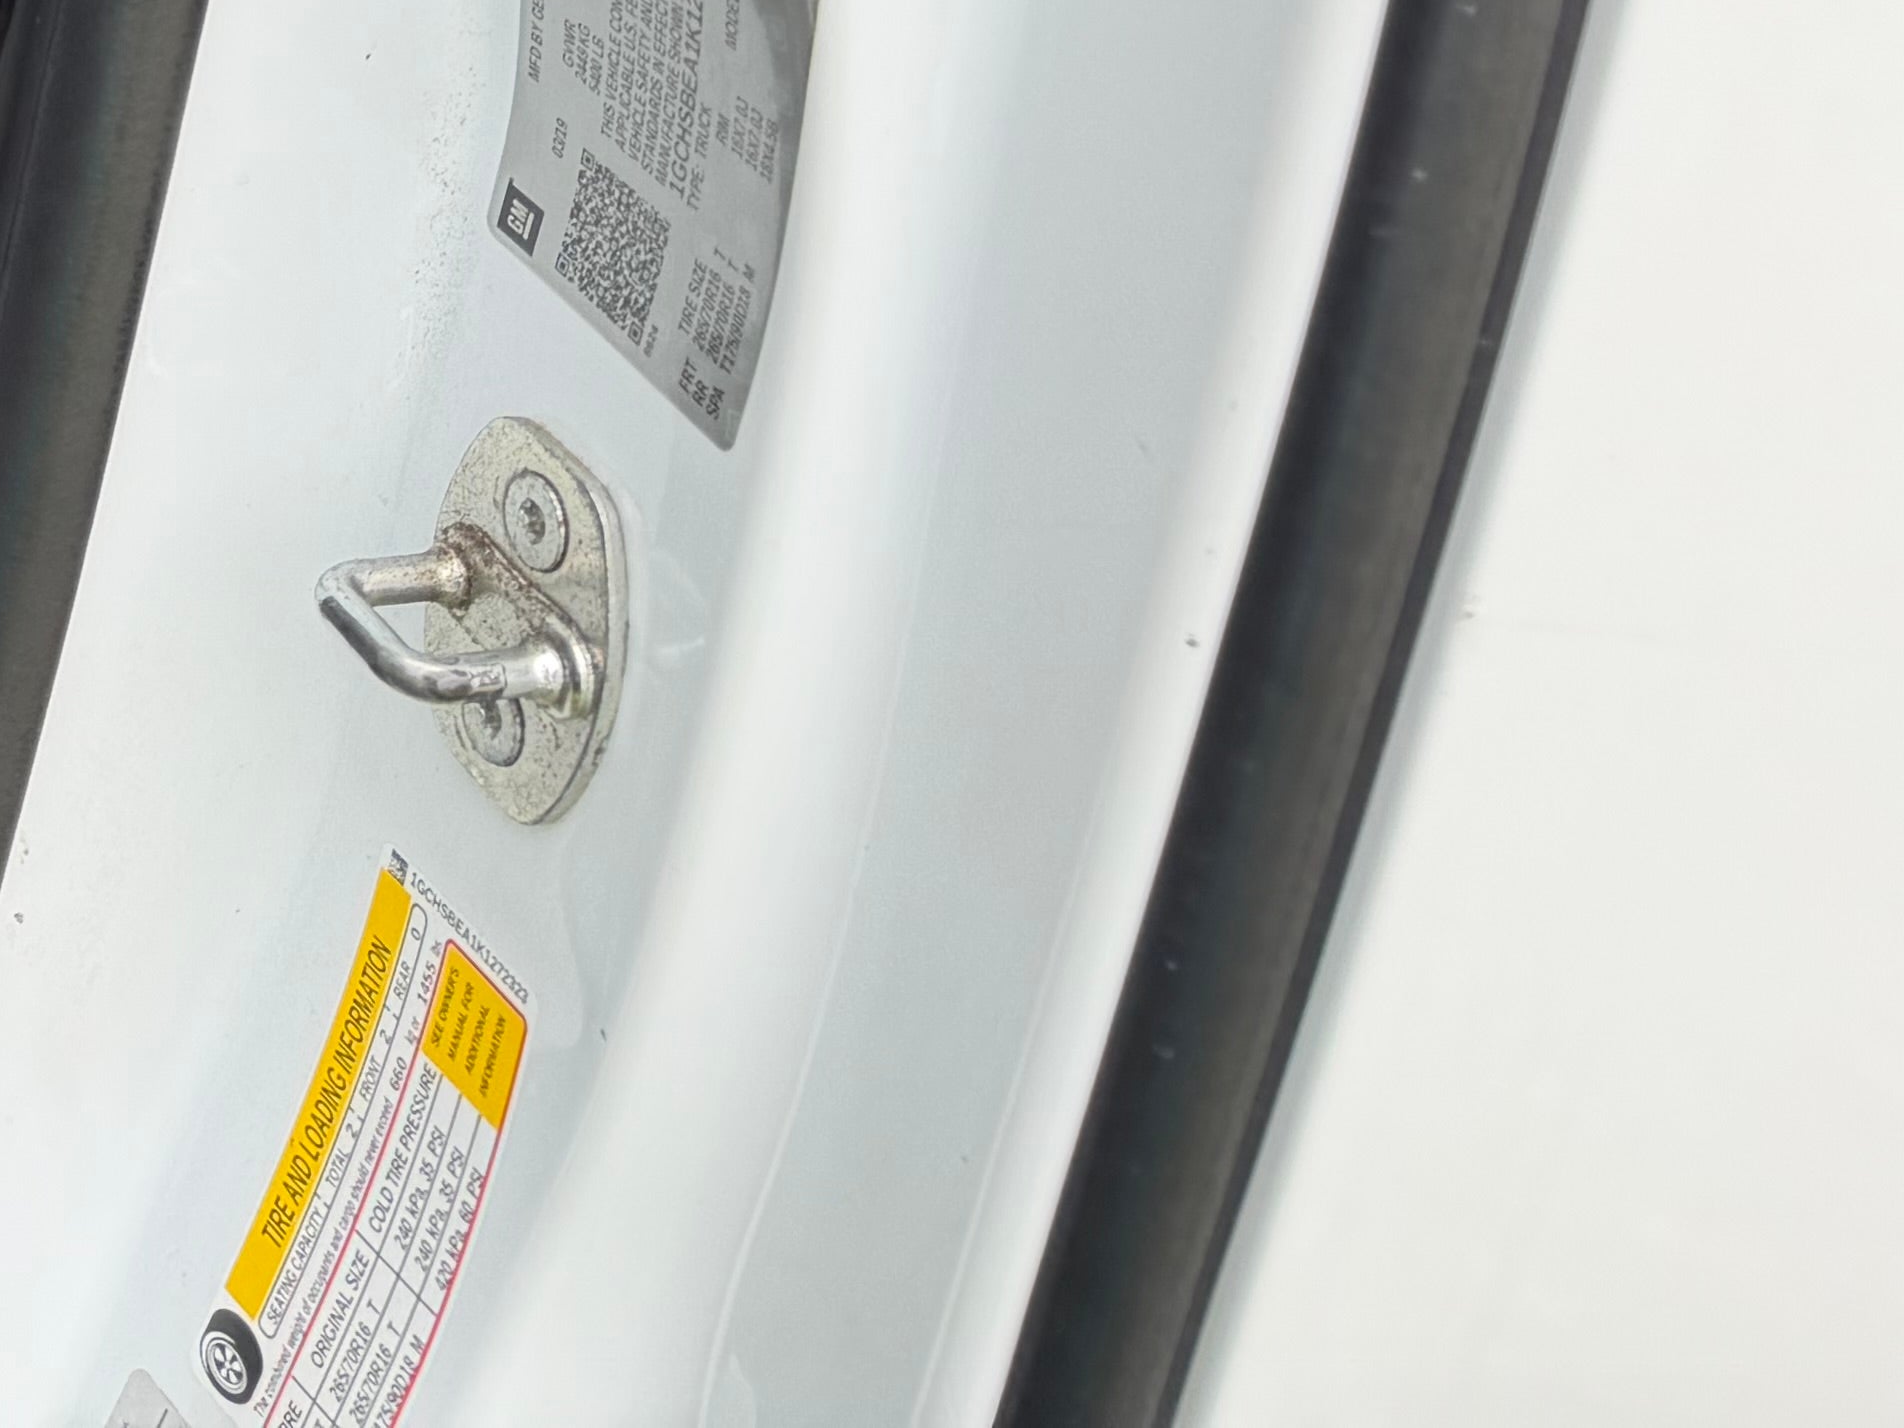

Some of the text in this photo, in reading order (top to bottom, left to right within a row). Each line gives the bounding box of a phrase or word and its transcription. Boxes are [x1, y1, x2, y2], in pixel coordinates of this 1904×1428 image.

[530, 21, 542, 47] BY
[605, 33, 621, 101] VEHICLE
[635, 28, 651, 94] SAFETY
[600, 102, 614, 138] THIS
[614, 51, 635, 153] APPLICABLE
[628, 93, 646, 162] VEHICLE
[640, 76, 663, 175] STANDARDS
[652, 56, 665, 76] IN
[654, 63, 680, 187] MANUFACTURE
[668, 2, 684, 64] SHOWN
[552, 117, 568, 159] 03/19
[694, 102, 712, 160] TRUCK
[507, 199, 529, 235] GM
[678, 296, 698, 336] TIRE
[688, 258, 708, 298] SIZE
[678, 357, 696, 395] FRT
[692, 380, 709, 408] RR
[706, 386, 725, 420] SPA
[390, 1056, 407, 1092] 660
[417, 960, 436, 1005] 1455
[431, 1022, 444, 1048] SEE
[448, 982, 474, 1062] MANUAL FOR
[465, 1005, 490, 1075] ADDITIONAL
[479, 1015, 506, 1098] INFORMATION
[261, 934, 391, 1248] TIRE AND LOADING INFORMATION
[267, 1269, 297, 1325] SEATING
[290, 1206, 324, 1271] CAPACITY
[325, 1148, 350, 1188] TOTAL
[359, 1054, 381, 1102] FRONT
[393, 960, 410, 1000] REAR
[419, 1158, 434, 1182] 35
[426, 1125, 445, 1158] PSI
[446, 1146, 464, 1179] PSI
[310, 1292, 354, 1369] ORIGINAL
[345, 1249, 370, 1292] SIZE
[368, 1186, 393, 1234] COLD
[385, 1148, 408, 1187] TIRE
[399, 1062, 437, 1152] PRESSURE
[439, 1179, 455, 1204] 35
[394, 1217, 412, 1251] 240
[414, 1239, 433, 1273] 240
[329, 1321, 372, 1403] 265/70R16
[349, 1343, 392, 1426] 265/70R16
